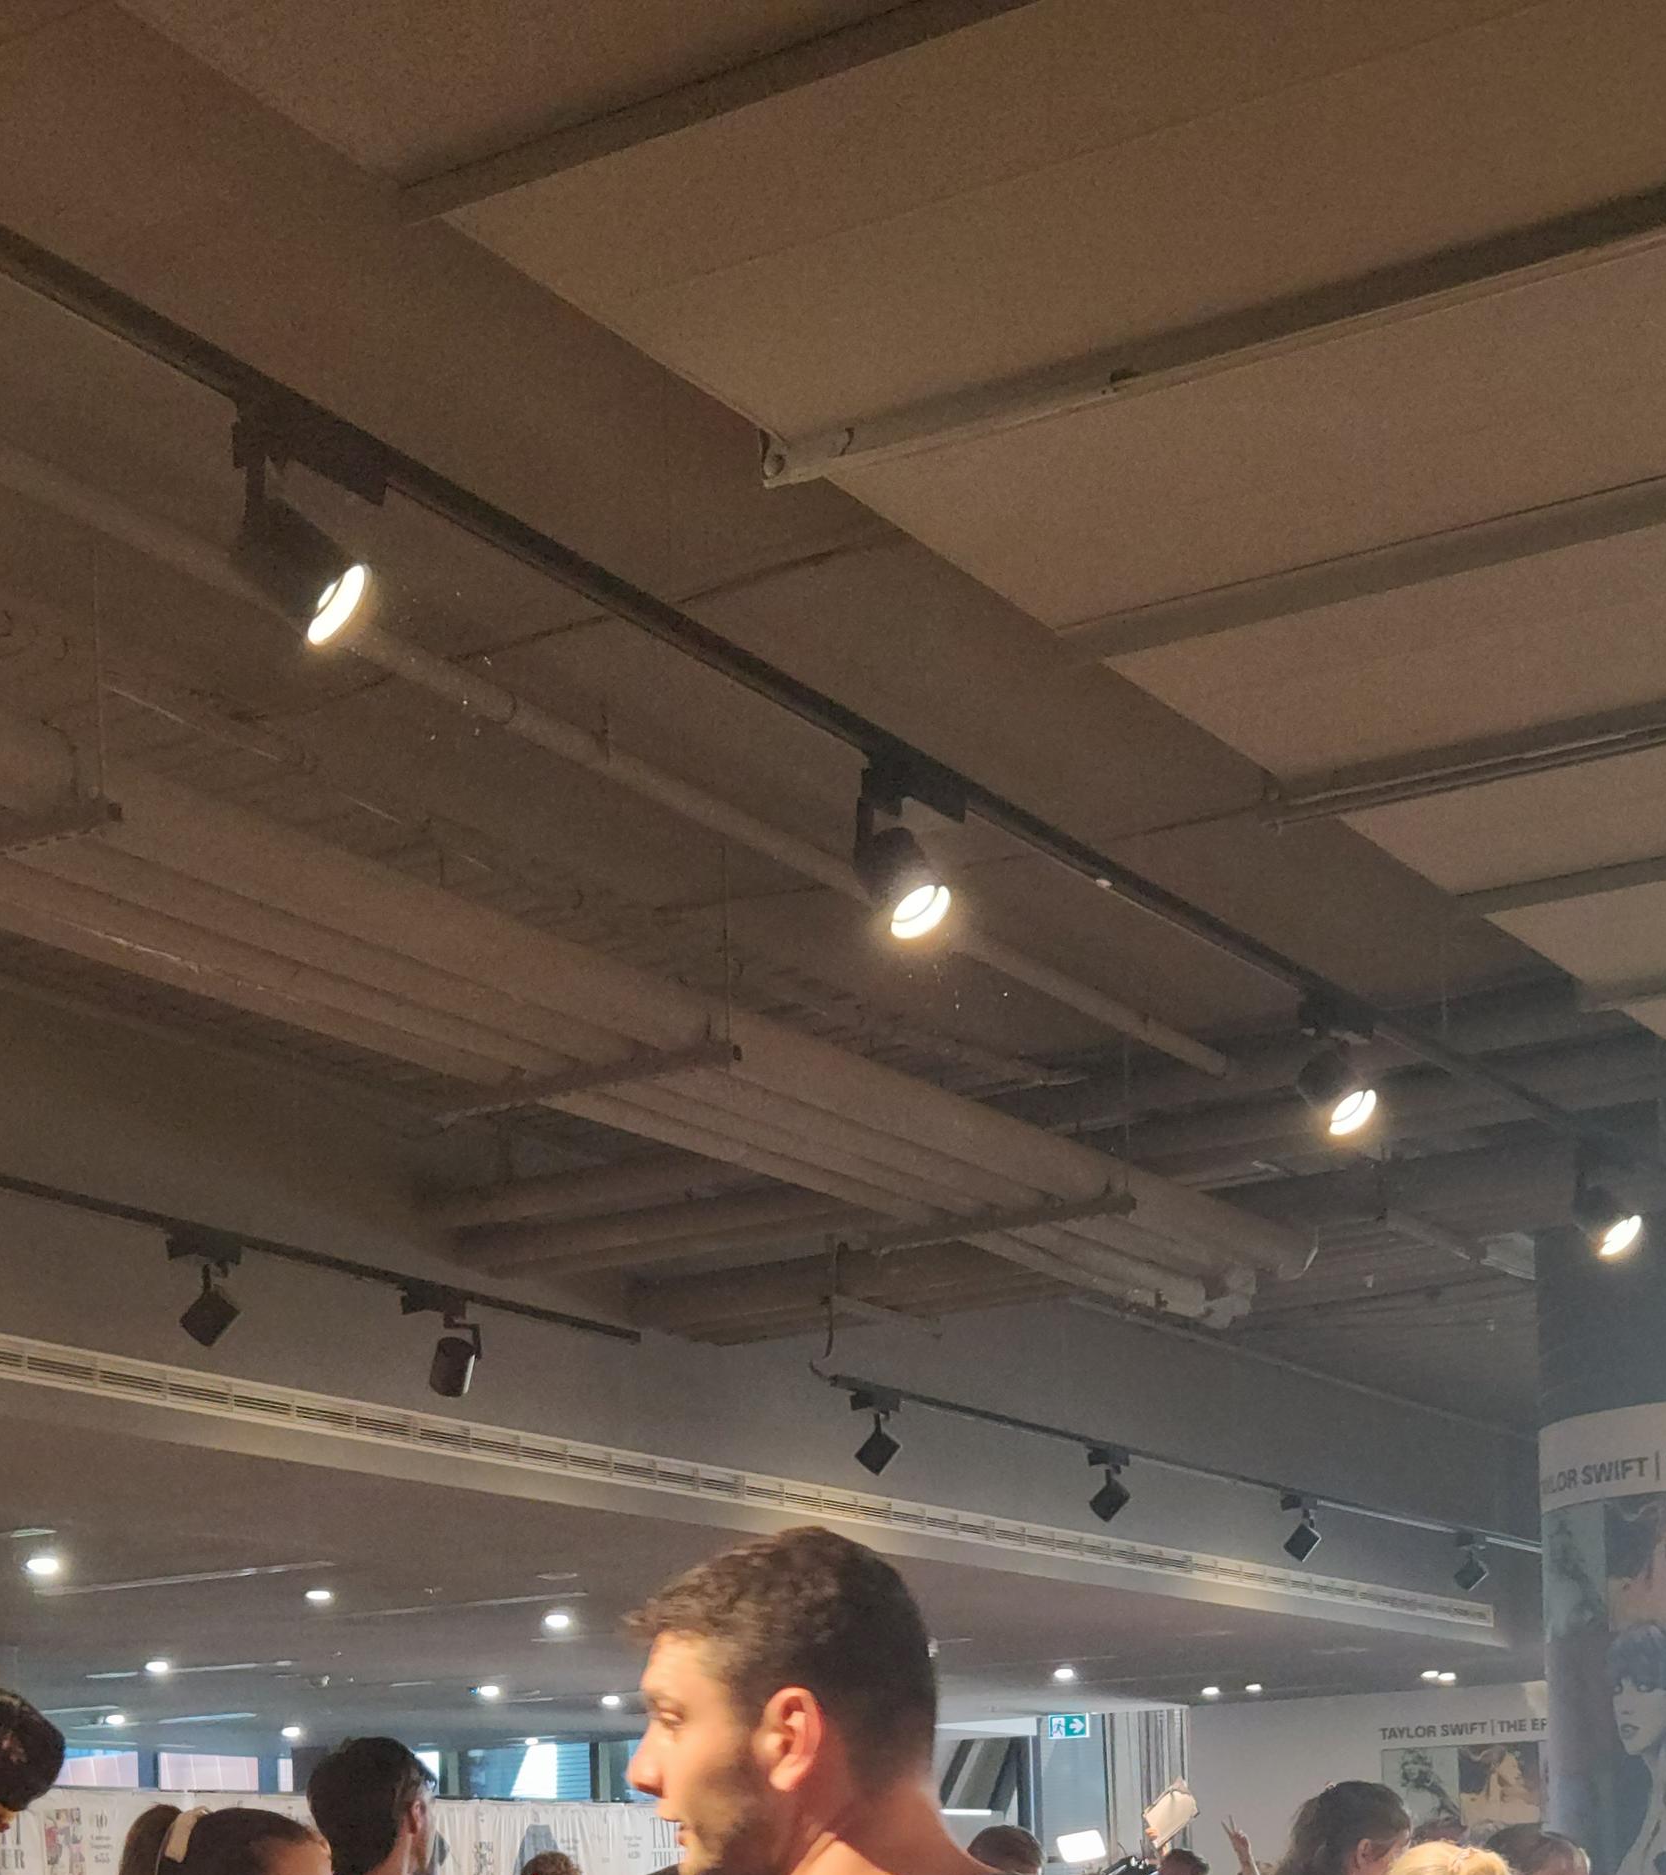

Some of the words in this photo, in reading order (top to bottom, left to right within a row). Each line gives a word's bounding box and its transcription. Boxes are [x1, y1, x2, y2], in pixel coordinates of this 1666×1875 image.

[1581, 1456, 1649, 1486] SWIFT
[1380, 1724, 1437, 1740] TAYLOR
[1440, 1721, 1487, 1737] SWIFT
[1497, 1719, 1527, 1733] THE
